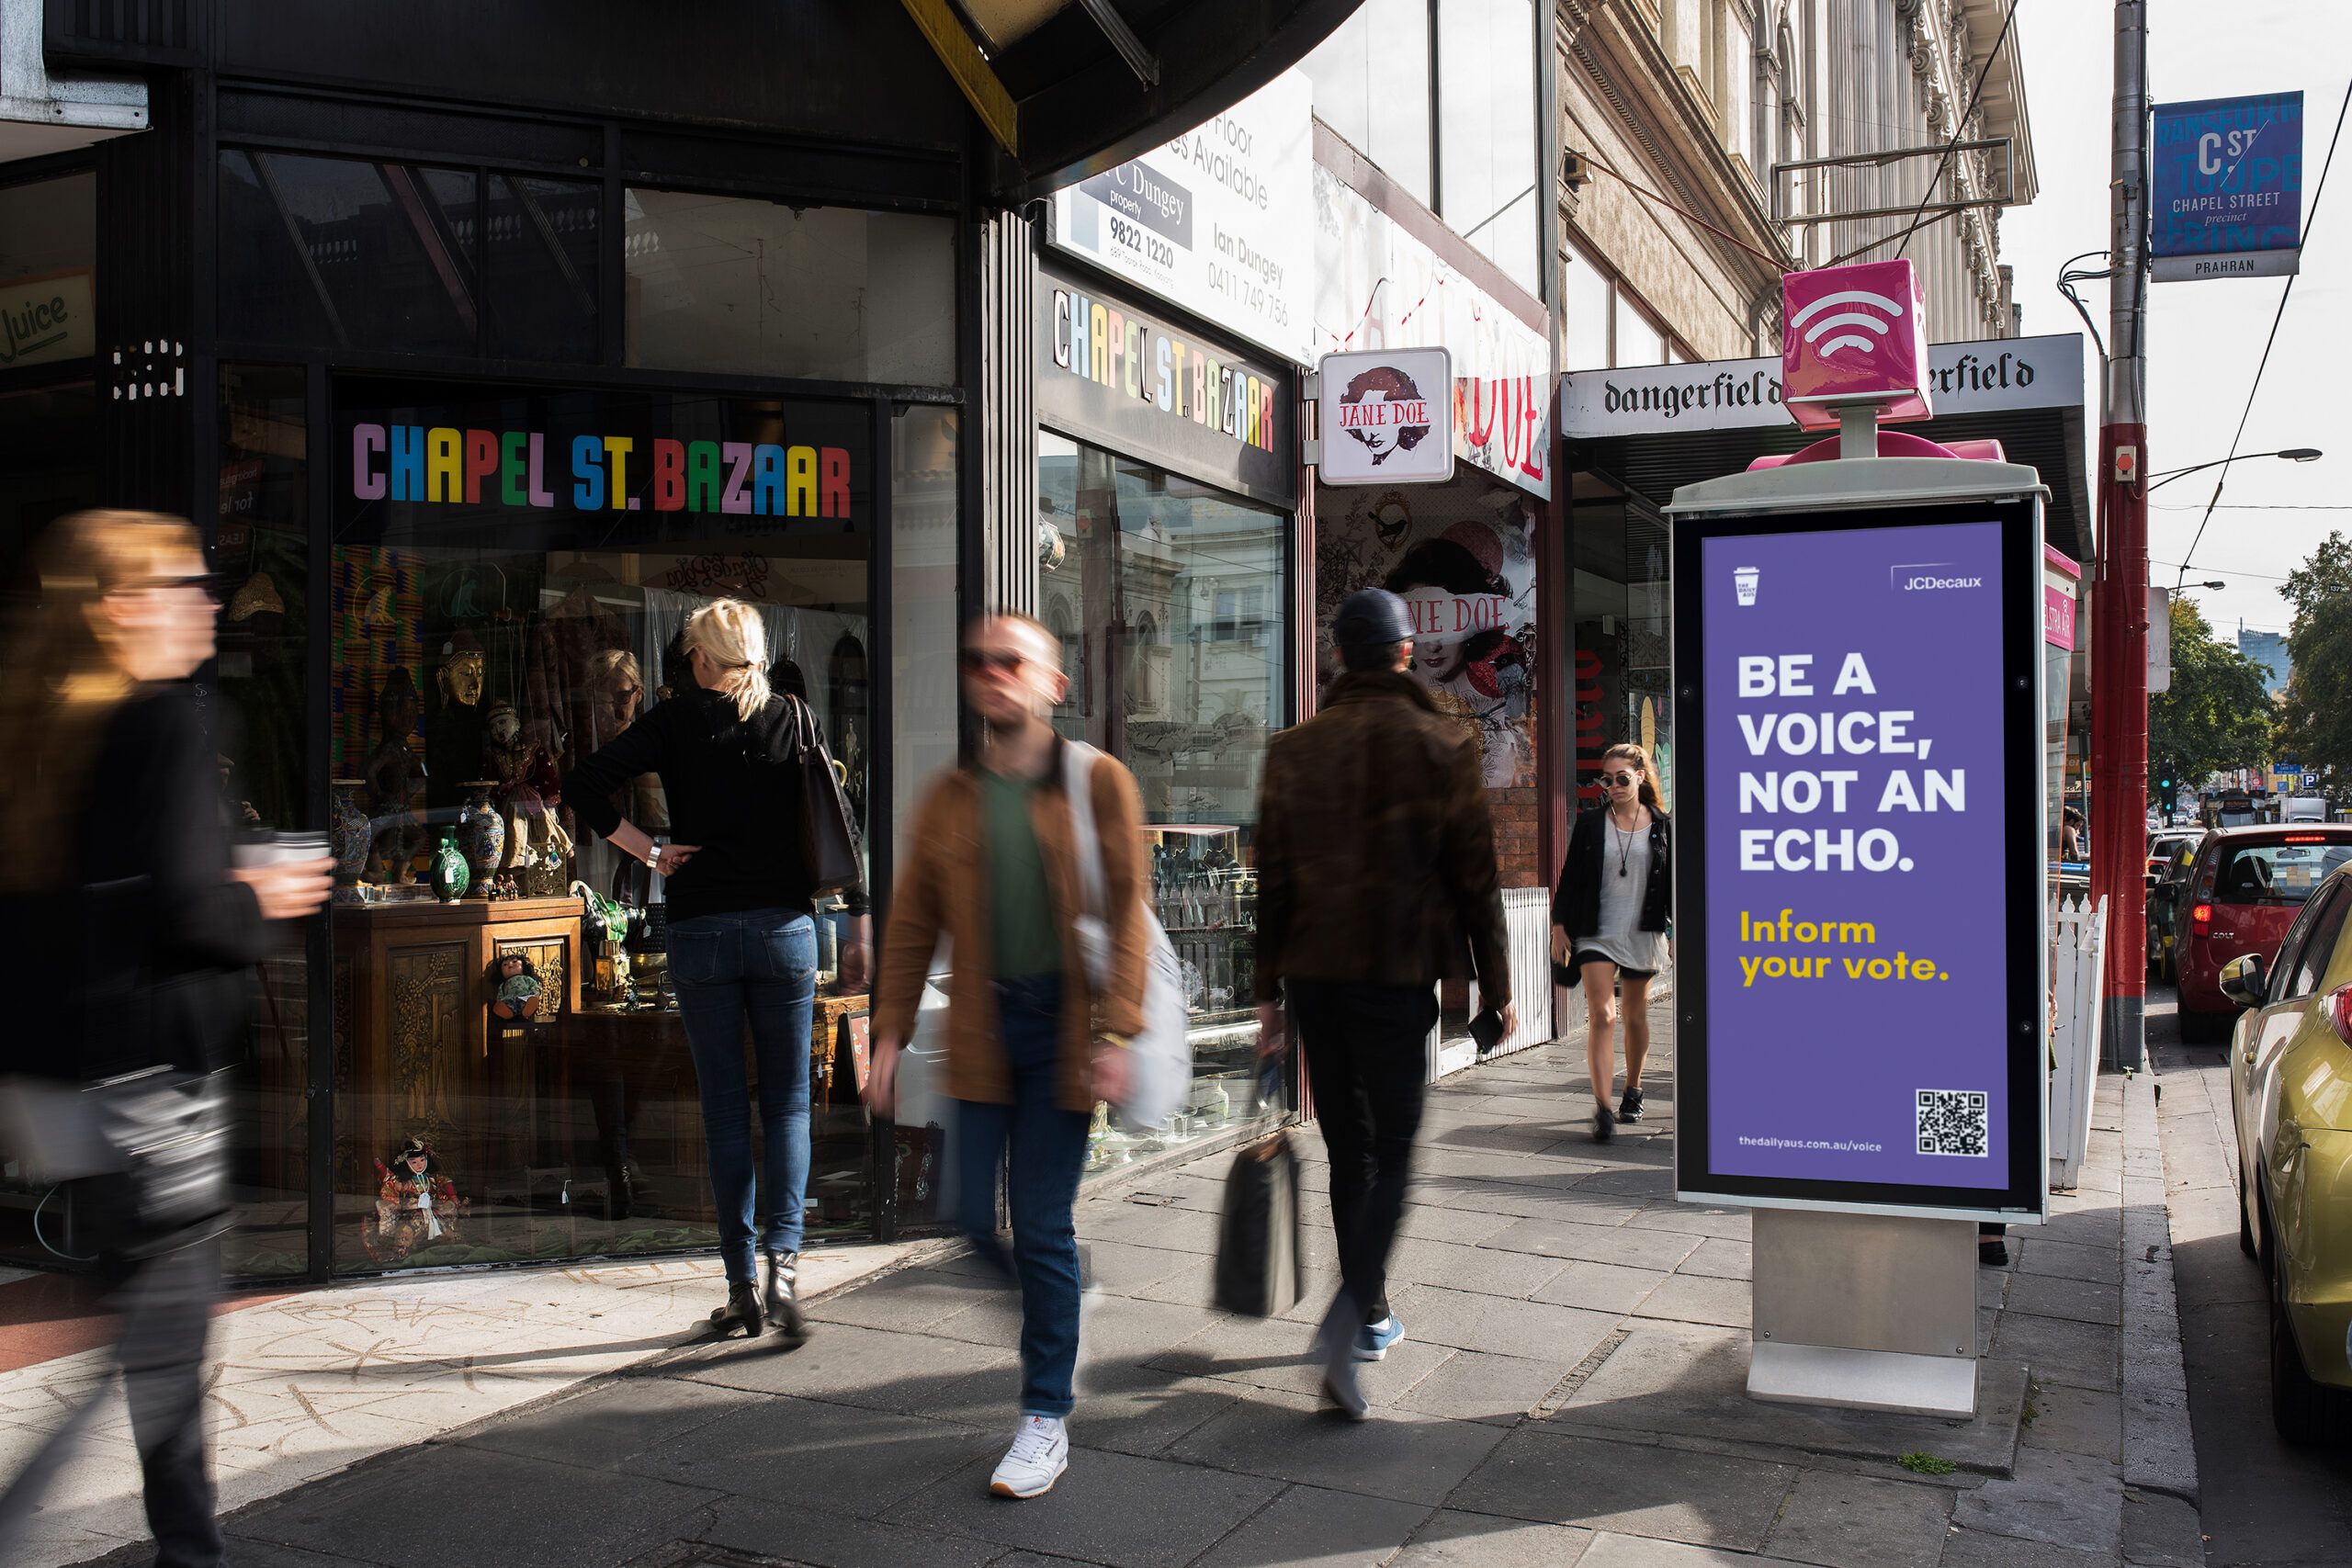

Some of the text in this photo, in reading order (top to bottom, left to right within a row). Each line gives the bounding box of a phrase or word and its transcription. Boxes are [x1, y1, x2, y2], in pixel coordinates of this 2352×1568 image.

[1193, 134, 1268, 210] Available
[1110, 189, 1142, 220] property
[1132, 164, 1184, 225] Dungey
[2173, 191, 2280, 213] CHAPEL STREET
[2204, 211, 2248, 227] precinct
[1110, 216, 1174, 269] 9822 1220
[1214, 222, 1284, 290] Ian Dungey
[2195, 259, 2255, 275] PRAHRAN
[1208, 262, 1288, 327] 0411 749 756
[0, 296, 68, 363] Juice
[1053, 288, 1274, 454] CHAPEL ST. BAZAAR
[1339, 400, 1430, 428] JANE DOE
[1604, 370, 1783, 419] dangerfield
[353, 423, 852, 519] CHAPEL ST. BAZAAR
[1904, 575, 1982, 592] JCDecaux
[1407, 595, 1510, 635] NE DOE
[2044, 604, 2061, 635] LSTRA
[1739, 653, 1877, 697] BE A
[1737, 710, 1933, 761] VOICE,
[1739, 770, 1965, 814] NOT AN
[2305, 775, 2315, 785] P
[1739, 829, 1915, 873] ECHO.
[1740, 908, 1876, 943] Inform
[2212, 931, 2234, 940] COLT
[1738, 951, 1949, 987] your vote.
[1738, 1135, 1883, 1153] thedailyaus.com.au/voice
